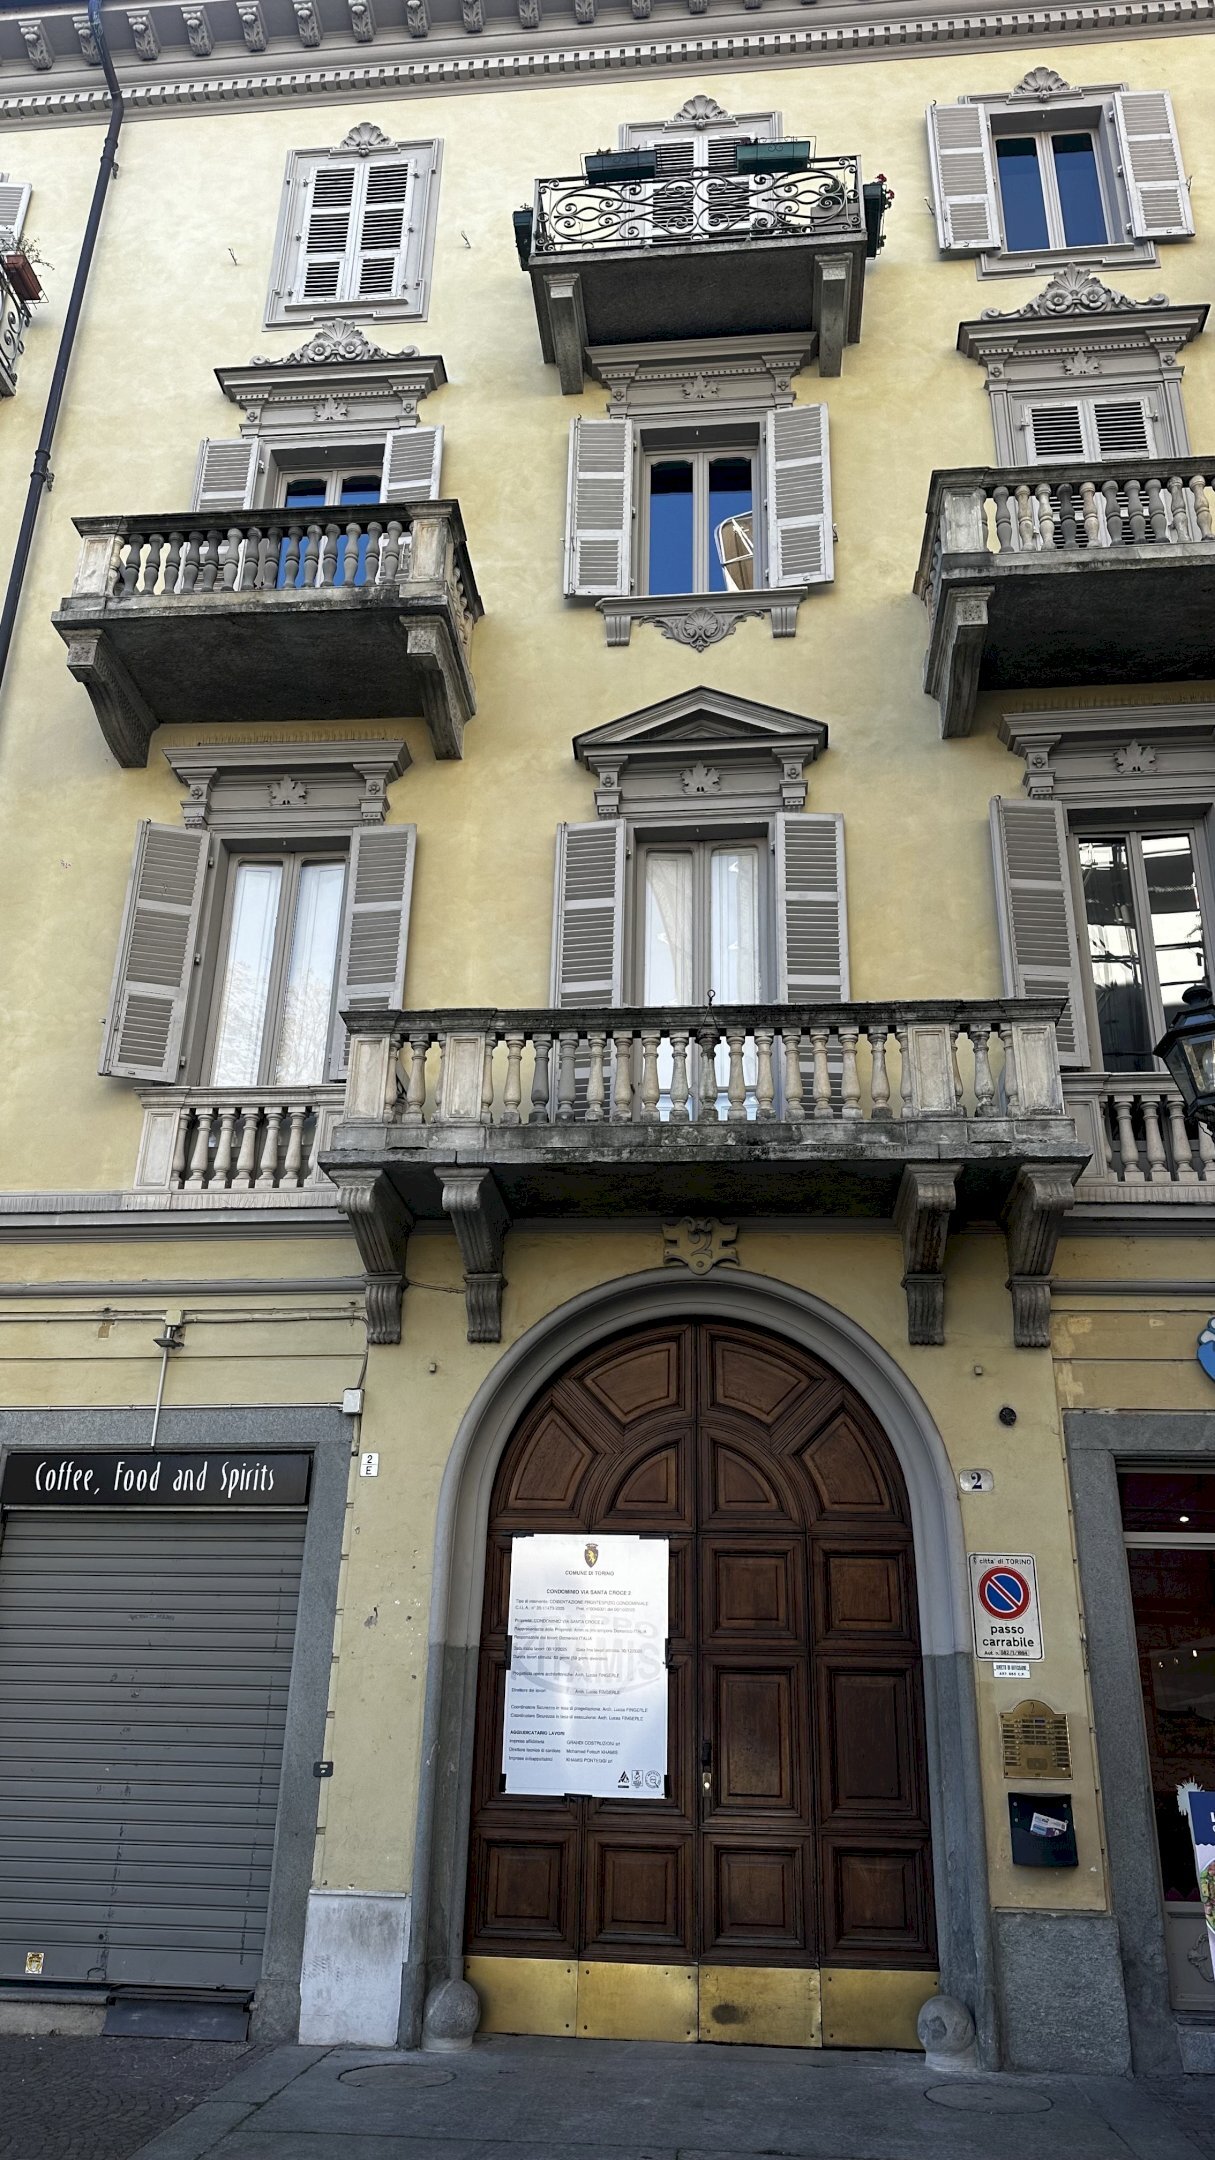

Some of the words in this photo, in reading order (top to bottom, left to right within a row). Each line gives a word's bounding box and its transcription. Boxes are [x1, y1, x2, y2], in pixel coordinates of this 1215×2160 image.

[367, 1454, 373, 1464] 2
[365, 1465, 373, 1475] E
[35, 1461, 100, 1495] Coffee,
[113, 1461, 161, 1492] Food
[172, 1461, 208, 1491] and
[219, 1461, 275, 1499] Spirits
[970, 1471, 983, 1490] 2
[990, 1626, 1025, 1636] passo
[983, 1637, 1035, 1648] carrabile
